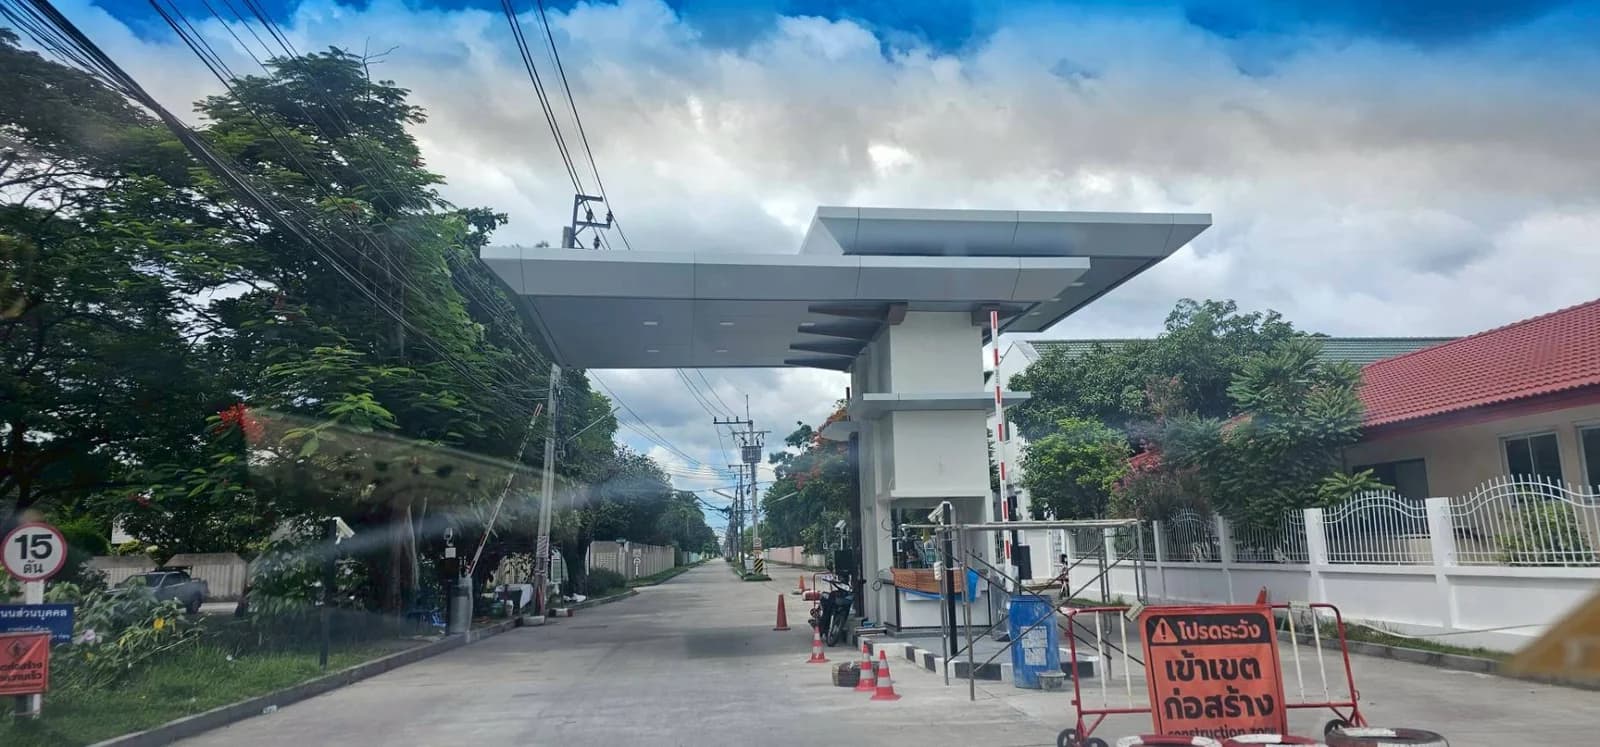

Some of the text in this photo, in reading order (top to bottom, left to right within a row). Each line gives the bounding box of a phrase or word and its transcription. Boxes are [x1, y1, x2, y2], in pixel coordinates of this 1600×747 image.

[15, 534, 52, 560] 15
[23, 560, 44, 574] ตัน
[1177, 619, 1262, 640] โปรดระวัง
[1165, 650, 1262, 682] เข้าเขต
[1164, 685, 1274, 720] ก่อสร้าง
